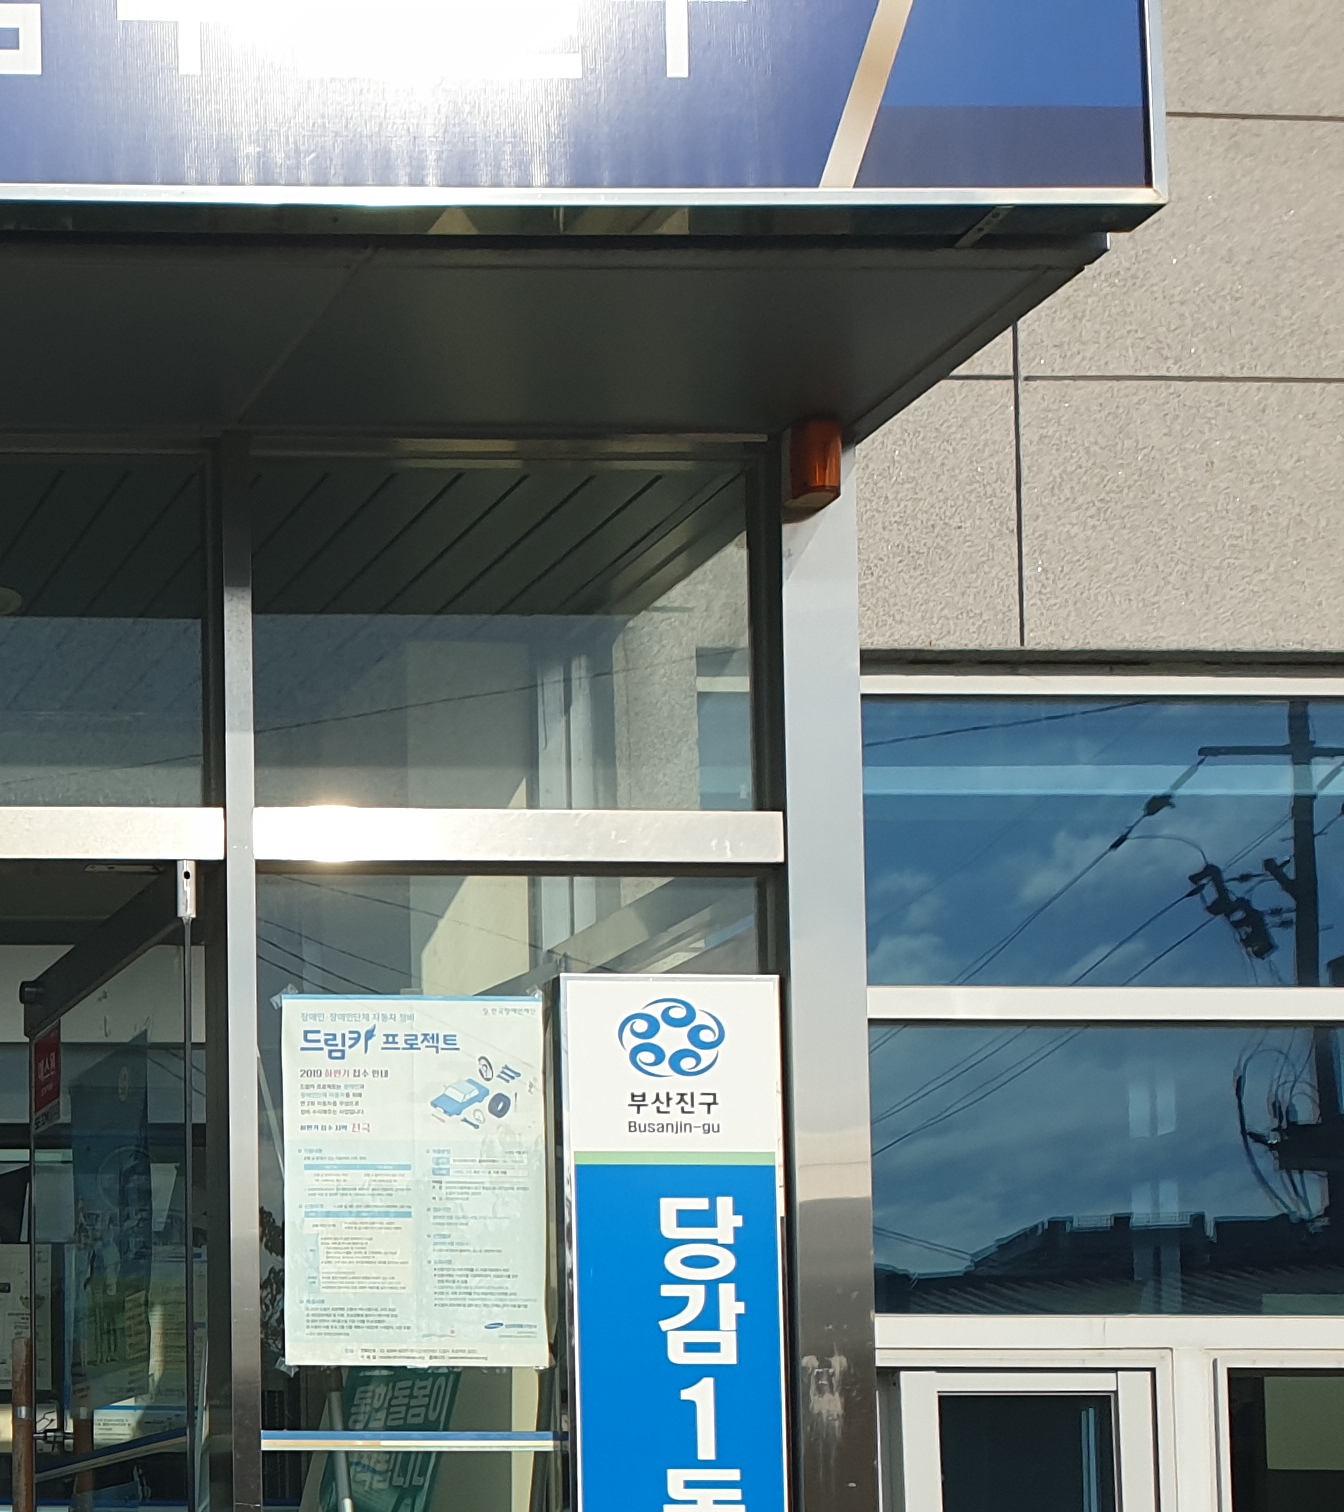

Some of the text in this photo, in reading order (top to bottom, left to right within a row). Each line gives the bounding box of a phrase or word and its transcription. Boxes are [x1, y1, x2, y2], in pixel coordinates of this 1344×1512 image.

[300, 1024, 460, 1060] 드림카 프로젝트
[300, 1069, 322, 1078] 2019
[628, 1092, 719, 1116] 부산진구
[628, 1119, 720, 1135] Busanjin-gu
